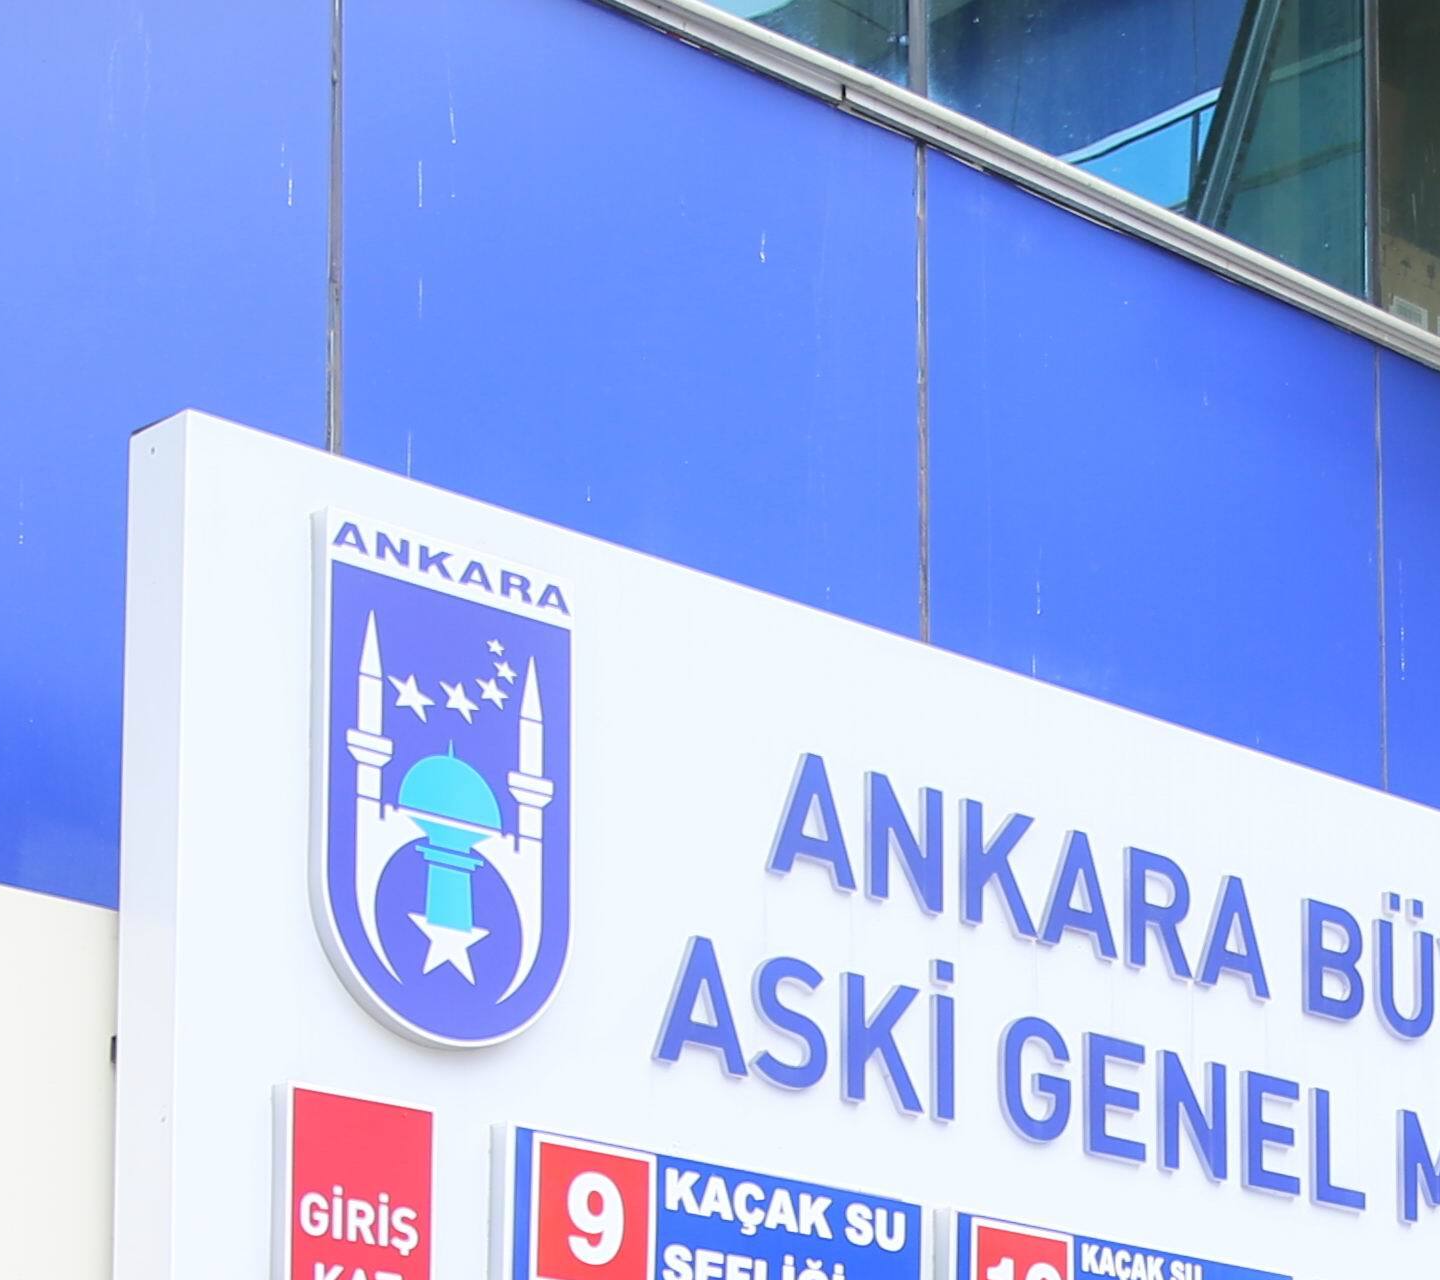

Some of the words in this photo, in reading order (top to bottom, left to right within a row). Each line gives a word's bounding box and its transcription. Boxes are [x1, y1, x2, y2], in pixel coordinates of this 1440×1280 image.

[332, 521, 571, 617] ANKARA
[765, 752, 1271, 1002] ANKARA
[651, 934, 955, 1124] ASKİ
[998, 1016, 1366, 1212] GENEL
[299, 1185, 420, 1256] GİRİŞ
[566, 1171, 626, 1267] 9
[664, 1167, 834, 1239] KAÇAK
[845, 1203, 907, 1253] SU
